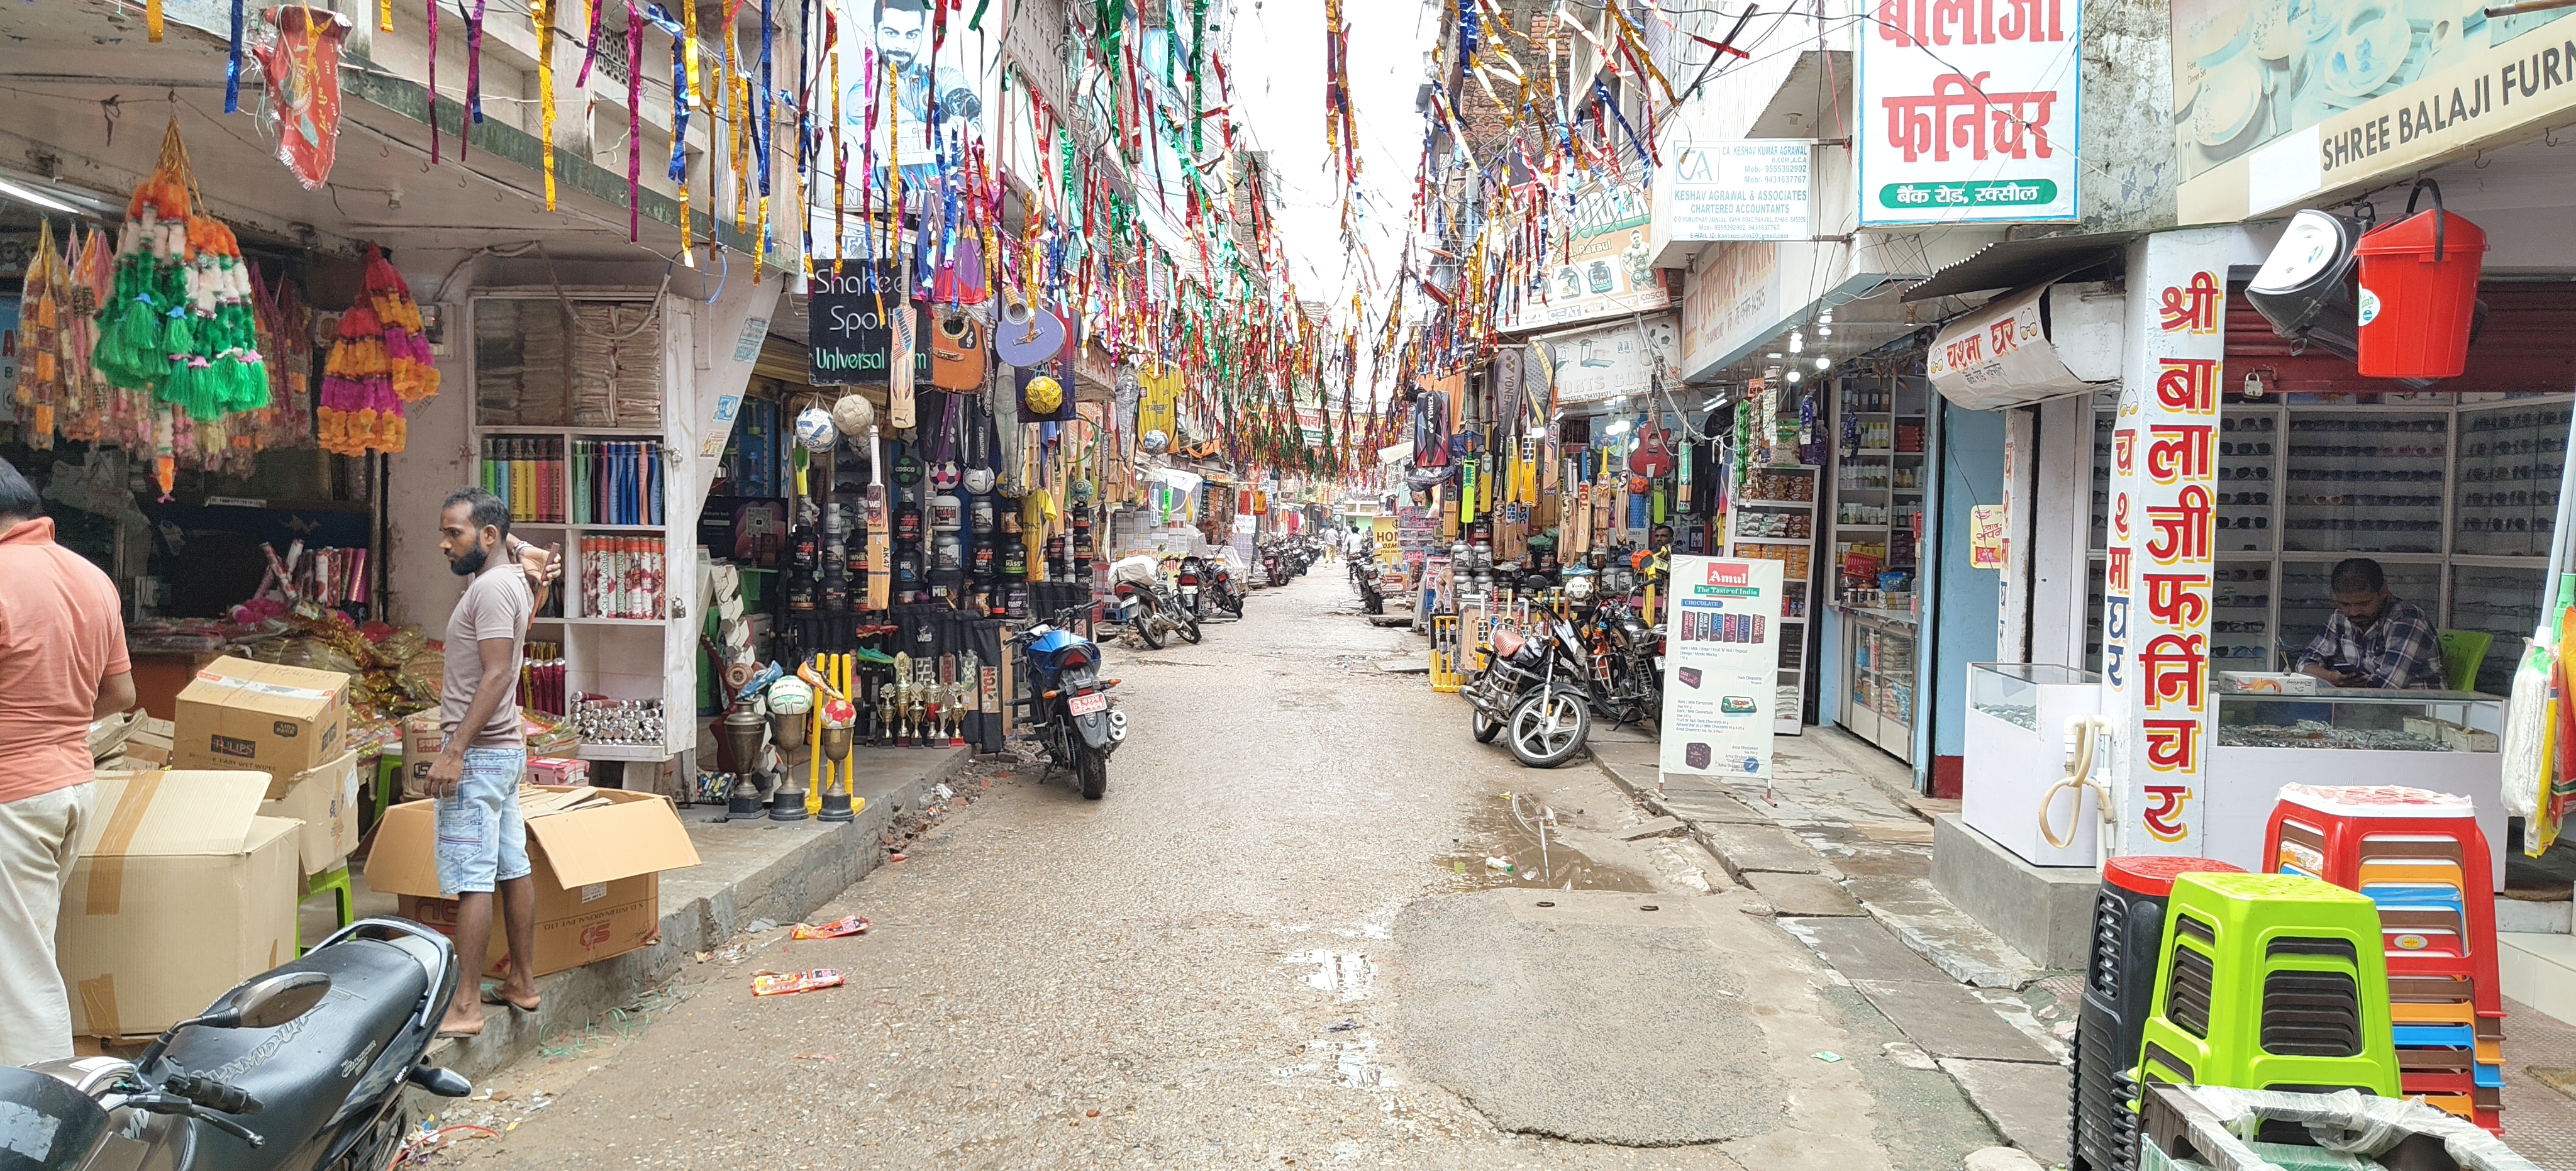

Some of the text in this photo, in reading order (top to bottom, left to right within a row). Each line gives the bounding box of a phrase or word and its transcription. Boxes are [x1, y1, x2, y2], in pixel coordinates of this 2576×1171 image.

[2187, 73, 2200, 86] Dinner
[1882, 71, 2057, 163] फर्निचर
[2323, 114, 2390, 172] SHREE
[2399, 73, 2491, 144] BALAJI
[1733, 146, 1756, 155] KESHAV
[1758, 146, 1778, 155] KUMAR
[1780, 145, 1807, 155] AGRAWAL
[1765, 165, 1807, 173] 9555392902
[1675, 190, 1807, 201] KESHAV AGRAWAL & ASSOCIATES
[1897, 184, 1931, 204] बैंक
[1975, 182, 2040, 202] रक्सौल
[1690, 204, 1789, 214] CHARTERED ACCOUNTANTS
[1577, 239, 1612, 257] Raxaul
[1641, 290, 1665, 301] COSCO
[1548, 306, 1580, 321] CEAT
[1946, 316, 2019, 370] चश्मा घर
[1504, 375, 1514, 408] YONEX
[1579, 484, 1588, 509] TON
[2138, 270, 2223, 843] श्री बालाजी फर्निचर
[1709, 570, 1746, 584] Amul
[932, 587, 948, 597] MB
[580, 906, 628, 925] INTERNATIONAL
